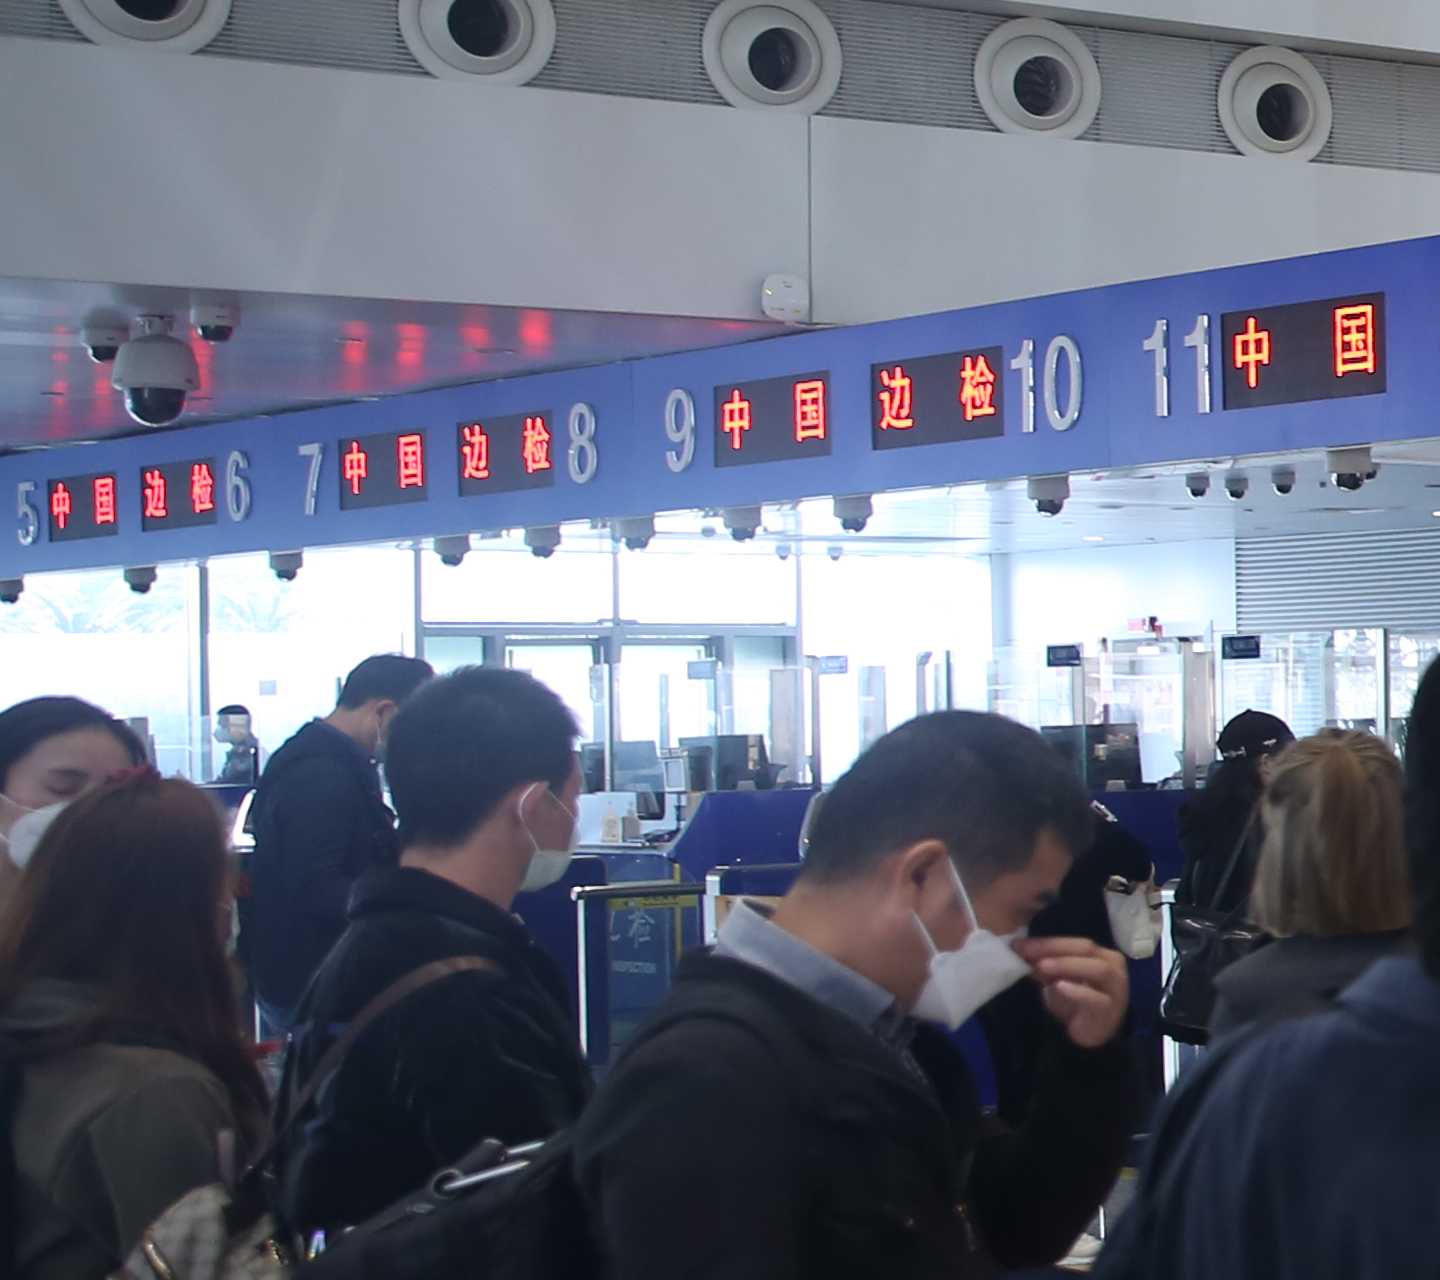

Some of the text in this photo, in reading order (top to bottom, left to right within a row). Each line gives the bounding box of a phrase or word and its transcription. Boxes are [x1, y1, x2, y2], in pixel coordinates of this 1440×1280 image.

[1143, 315, 1211, 417] 11
[1233, 303, 1376, 389] 中国
[721, 379, 826, 450] 中国
[878, 355, 997, 432] 边检
[1011, 335, 1083, 433] 10
[343, 433, 426, 495] 中国
[460, 415, 552, 481] 边检
[568, 401, 599, 485] 8
[664, 387, 696, 473] 9
[16, 481, 39, 546] 5
[51, 476, 117, 529] 中国
[144, 463, 215, 519] 边检
[225, 450, 251, 522] 6
[298, 442, 323, 516] 7
